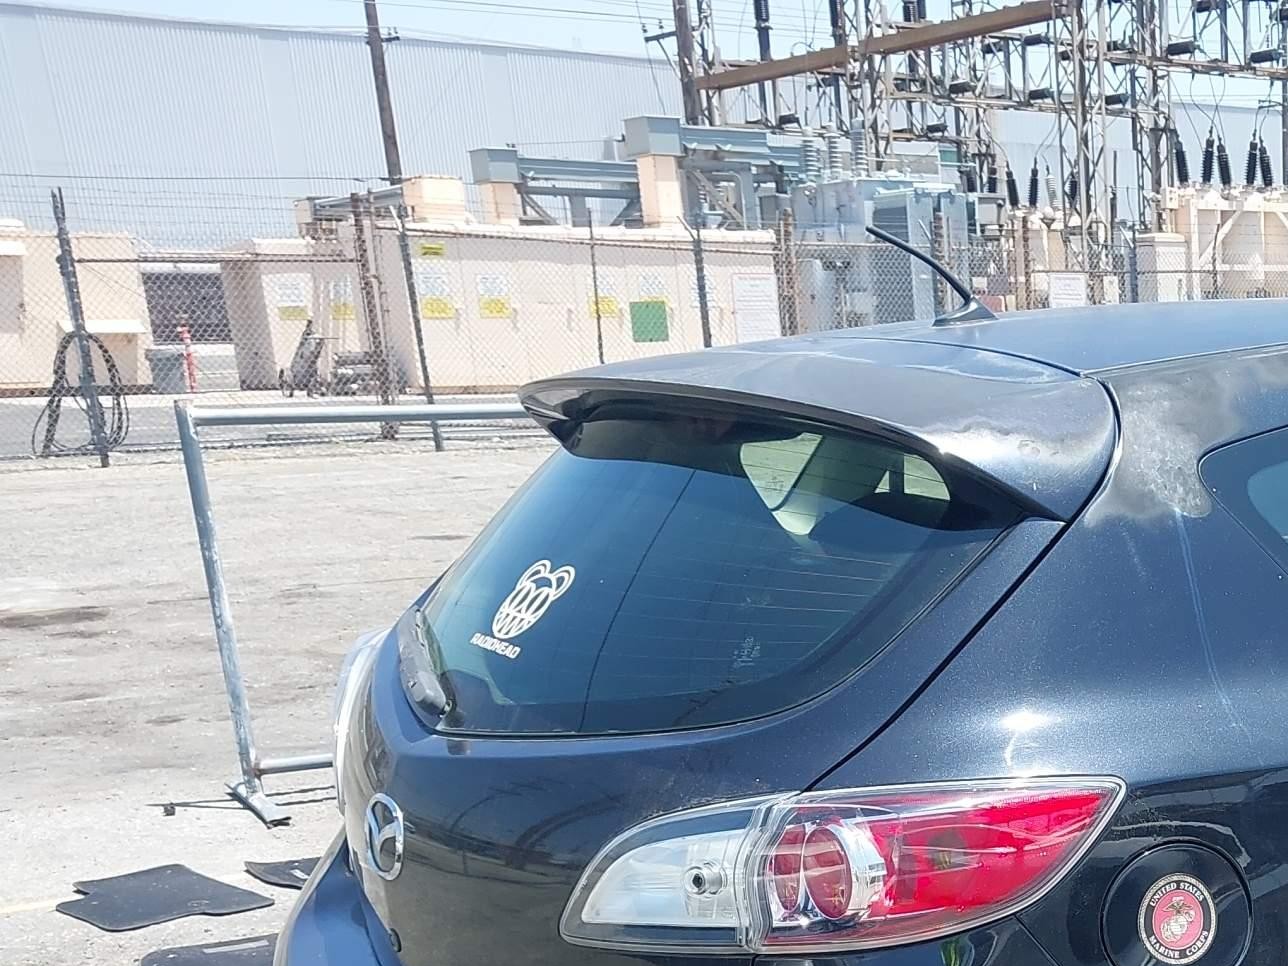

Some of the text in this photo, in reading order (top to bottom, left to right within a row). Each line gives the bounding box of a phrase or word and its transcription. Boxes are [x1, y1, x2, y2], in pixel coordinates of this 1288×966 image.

[470, 632, 521, 659] RADIOHEAD
[1149, 882, 1205, 907] UNITED STATES
[1149, 930, 1209, 959] MARINE CORPS
